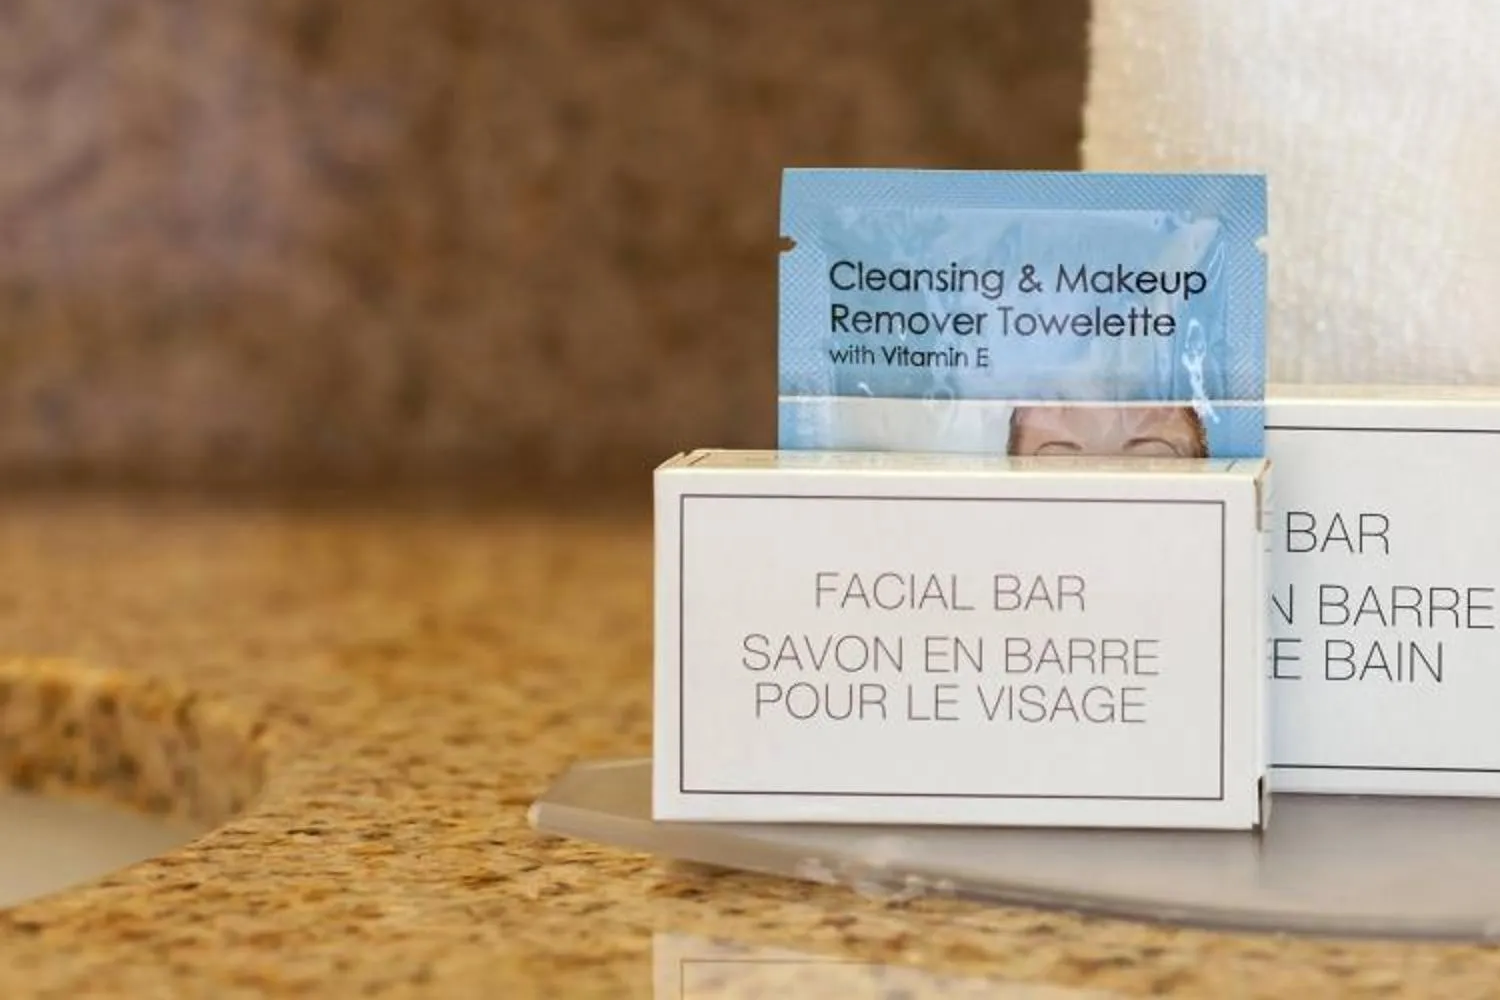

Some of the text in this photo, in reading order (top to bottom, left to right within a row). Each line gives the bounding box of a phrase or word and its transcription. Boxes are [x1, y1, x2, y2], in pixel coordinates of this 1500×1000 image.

[829, 260, 1208, 300] Cleansing & Makeup
[830, 304, 1176, 337] Remover Towelette
[829, 345, 990, 368] with Vitamin E
[1286, 511, 1390, 555] BAR
[814, 571, 1086, 612] FACIAL BAR
[1318, 583, 1496, 630] BARRE
[741, 633, 1161, 676] SAVON EN BARRE
[1324, 638, 1444, 683] BAIN
[754, 682, 1147, 724] POUR LE VISAGE
